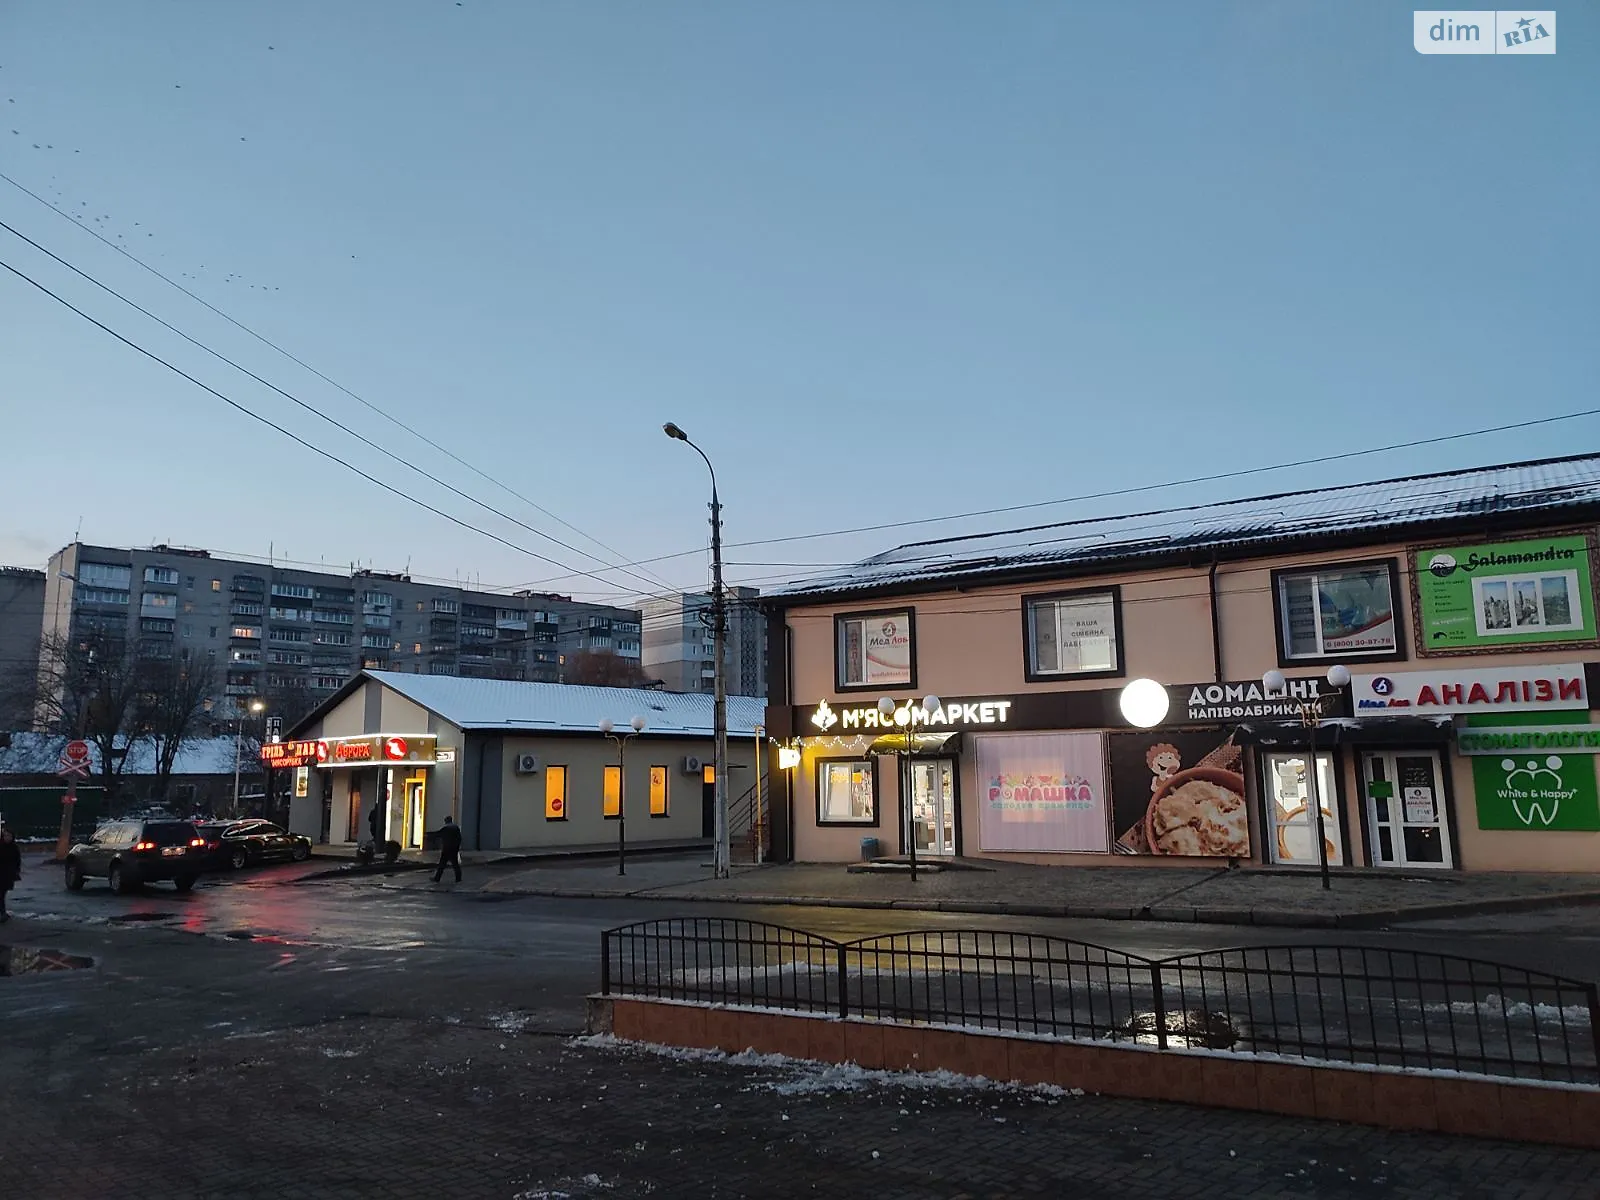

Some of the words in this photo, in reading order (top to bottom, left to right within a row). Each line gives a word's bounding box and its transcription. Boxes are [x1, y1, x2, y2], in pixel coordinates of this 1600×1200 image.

[1461, 546, 1575, 571] Salamandra
[870, 637, 890, 649] Мед
[1417, 678, 1582, 706] АНАЛІЗИ
[1188, 703, 1322, 719] НАПІВФАБРИКАТИ
[988, 786, 1092, 801] РОМАШКА
[1497, 788, 1528, 798] White
[1531, 789, 1538, 798] &
[1540, 789, 1574, 799] Happy
